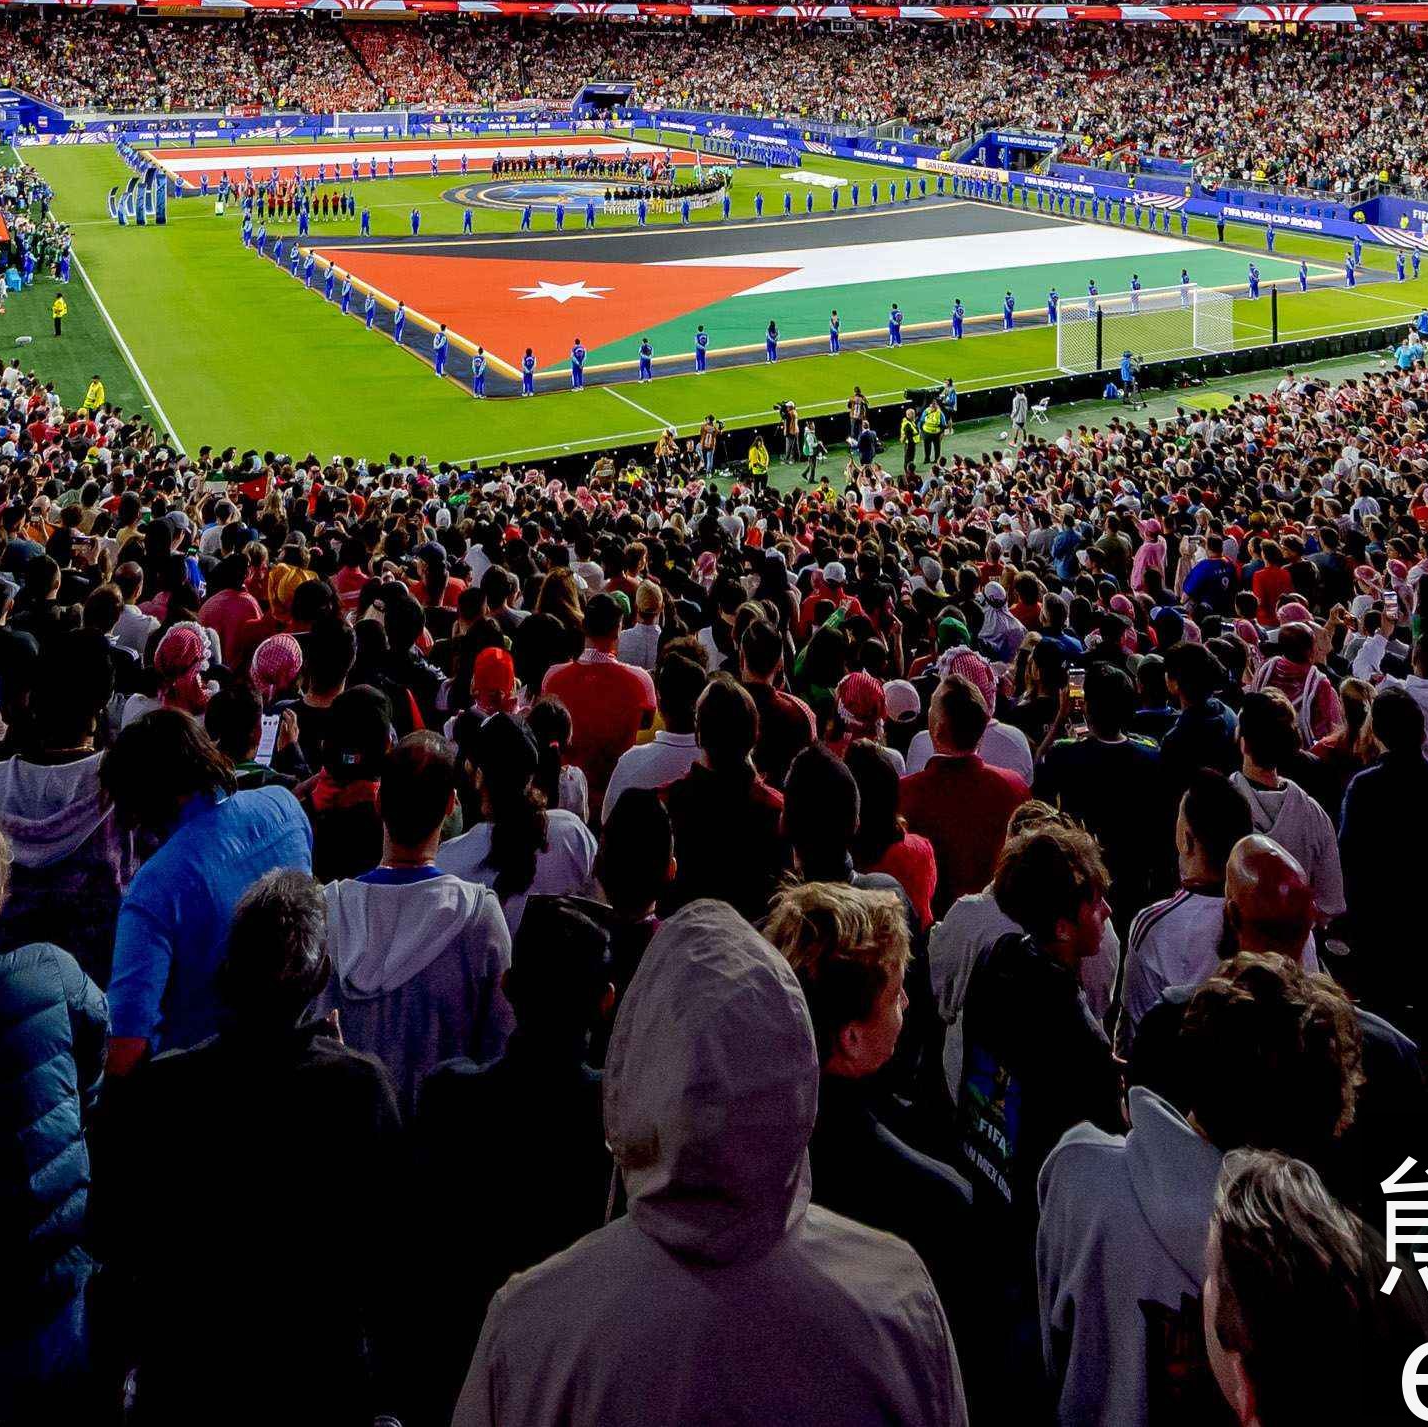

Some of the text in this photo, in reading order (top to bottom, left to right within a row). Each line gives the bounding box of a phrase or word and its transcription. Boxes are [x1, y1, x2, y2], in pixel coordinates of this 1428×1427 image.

[998, 135, 1009, 143] FIFA
[1009, 136, 1027, 144] WORLD
[1028, 138, 1037, 146] CUP
[1025, 176, 1037, 184] FIFA
[1037, 178, 1059, 188] WORLD
[1060, 181, 1071, 190] CUP
[1224, 207, 1323, 230] FIFA WORLD CUP 2026
[978, 1117, 1006, 1159] FIFA
